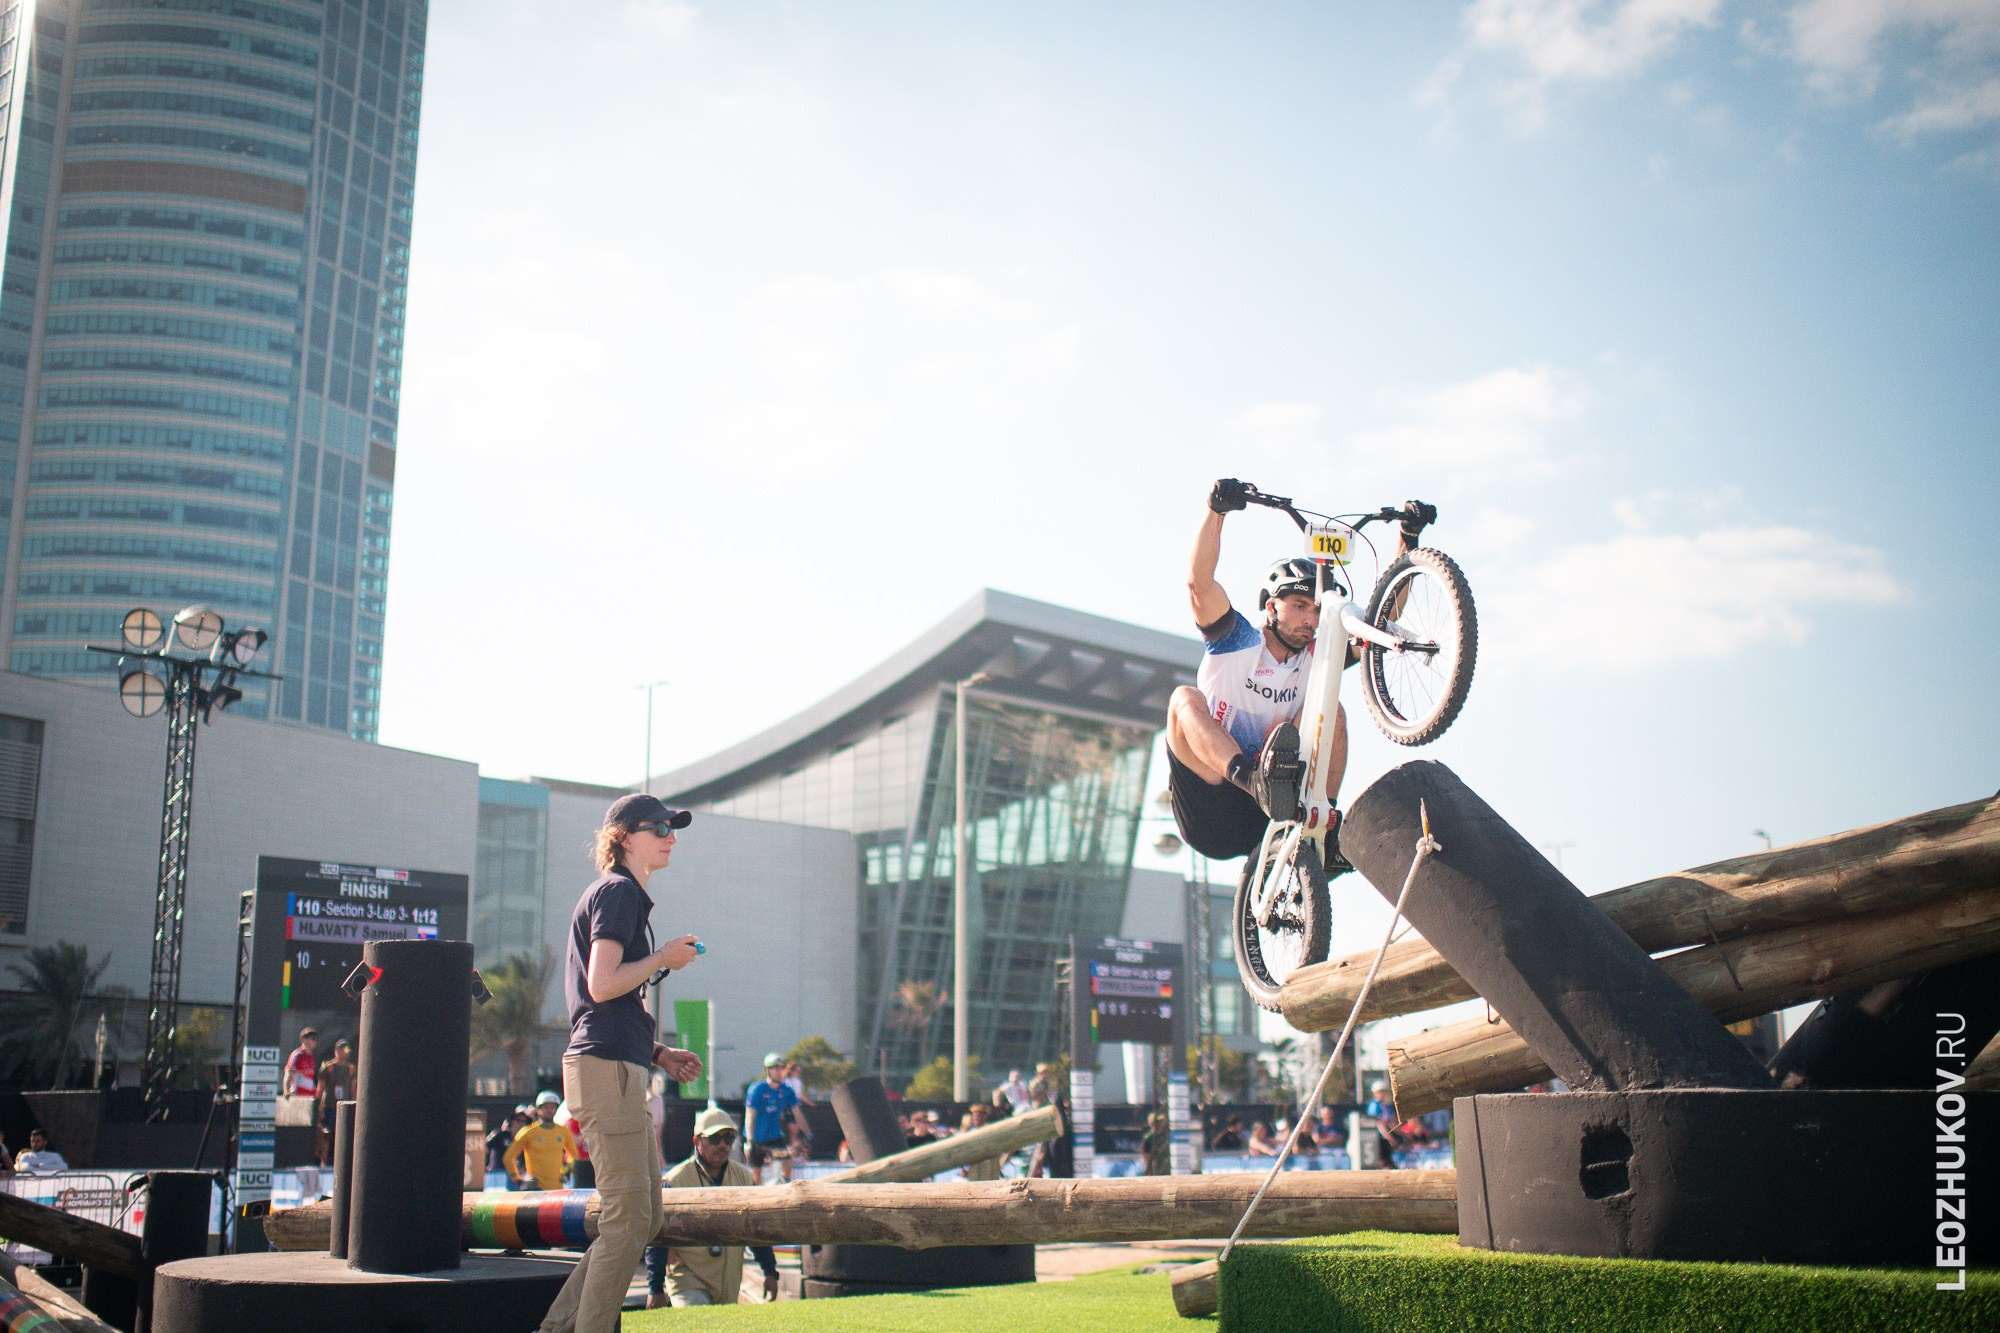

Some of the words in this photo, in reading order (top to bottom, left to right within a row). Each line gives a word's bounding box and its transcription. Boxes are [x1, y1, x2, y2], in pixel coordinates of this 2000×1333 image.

[1319, 537, 1342, 553] 110
[340, 882, 389, 900] FINISH
[296, 899, 320, 916] 110
[411, 907, 438, 925] 1:12
[299, 920, 358, 938] HLAVATY
[296, 950, 310, 969] 10
[253, 1050, 277, 1061] UCI
[246, 1173, 270, 1185] UCI
